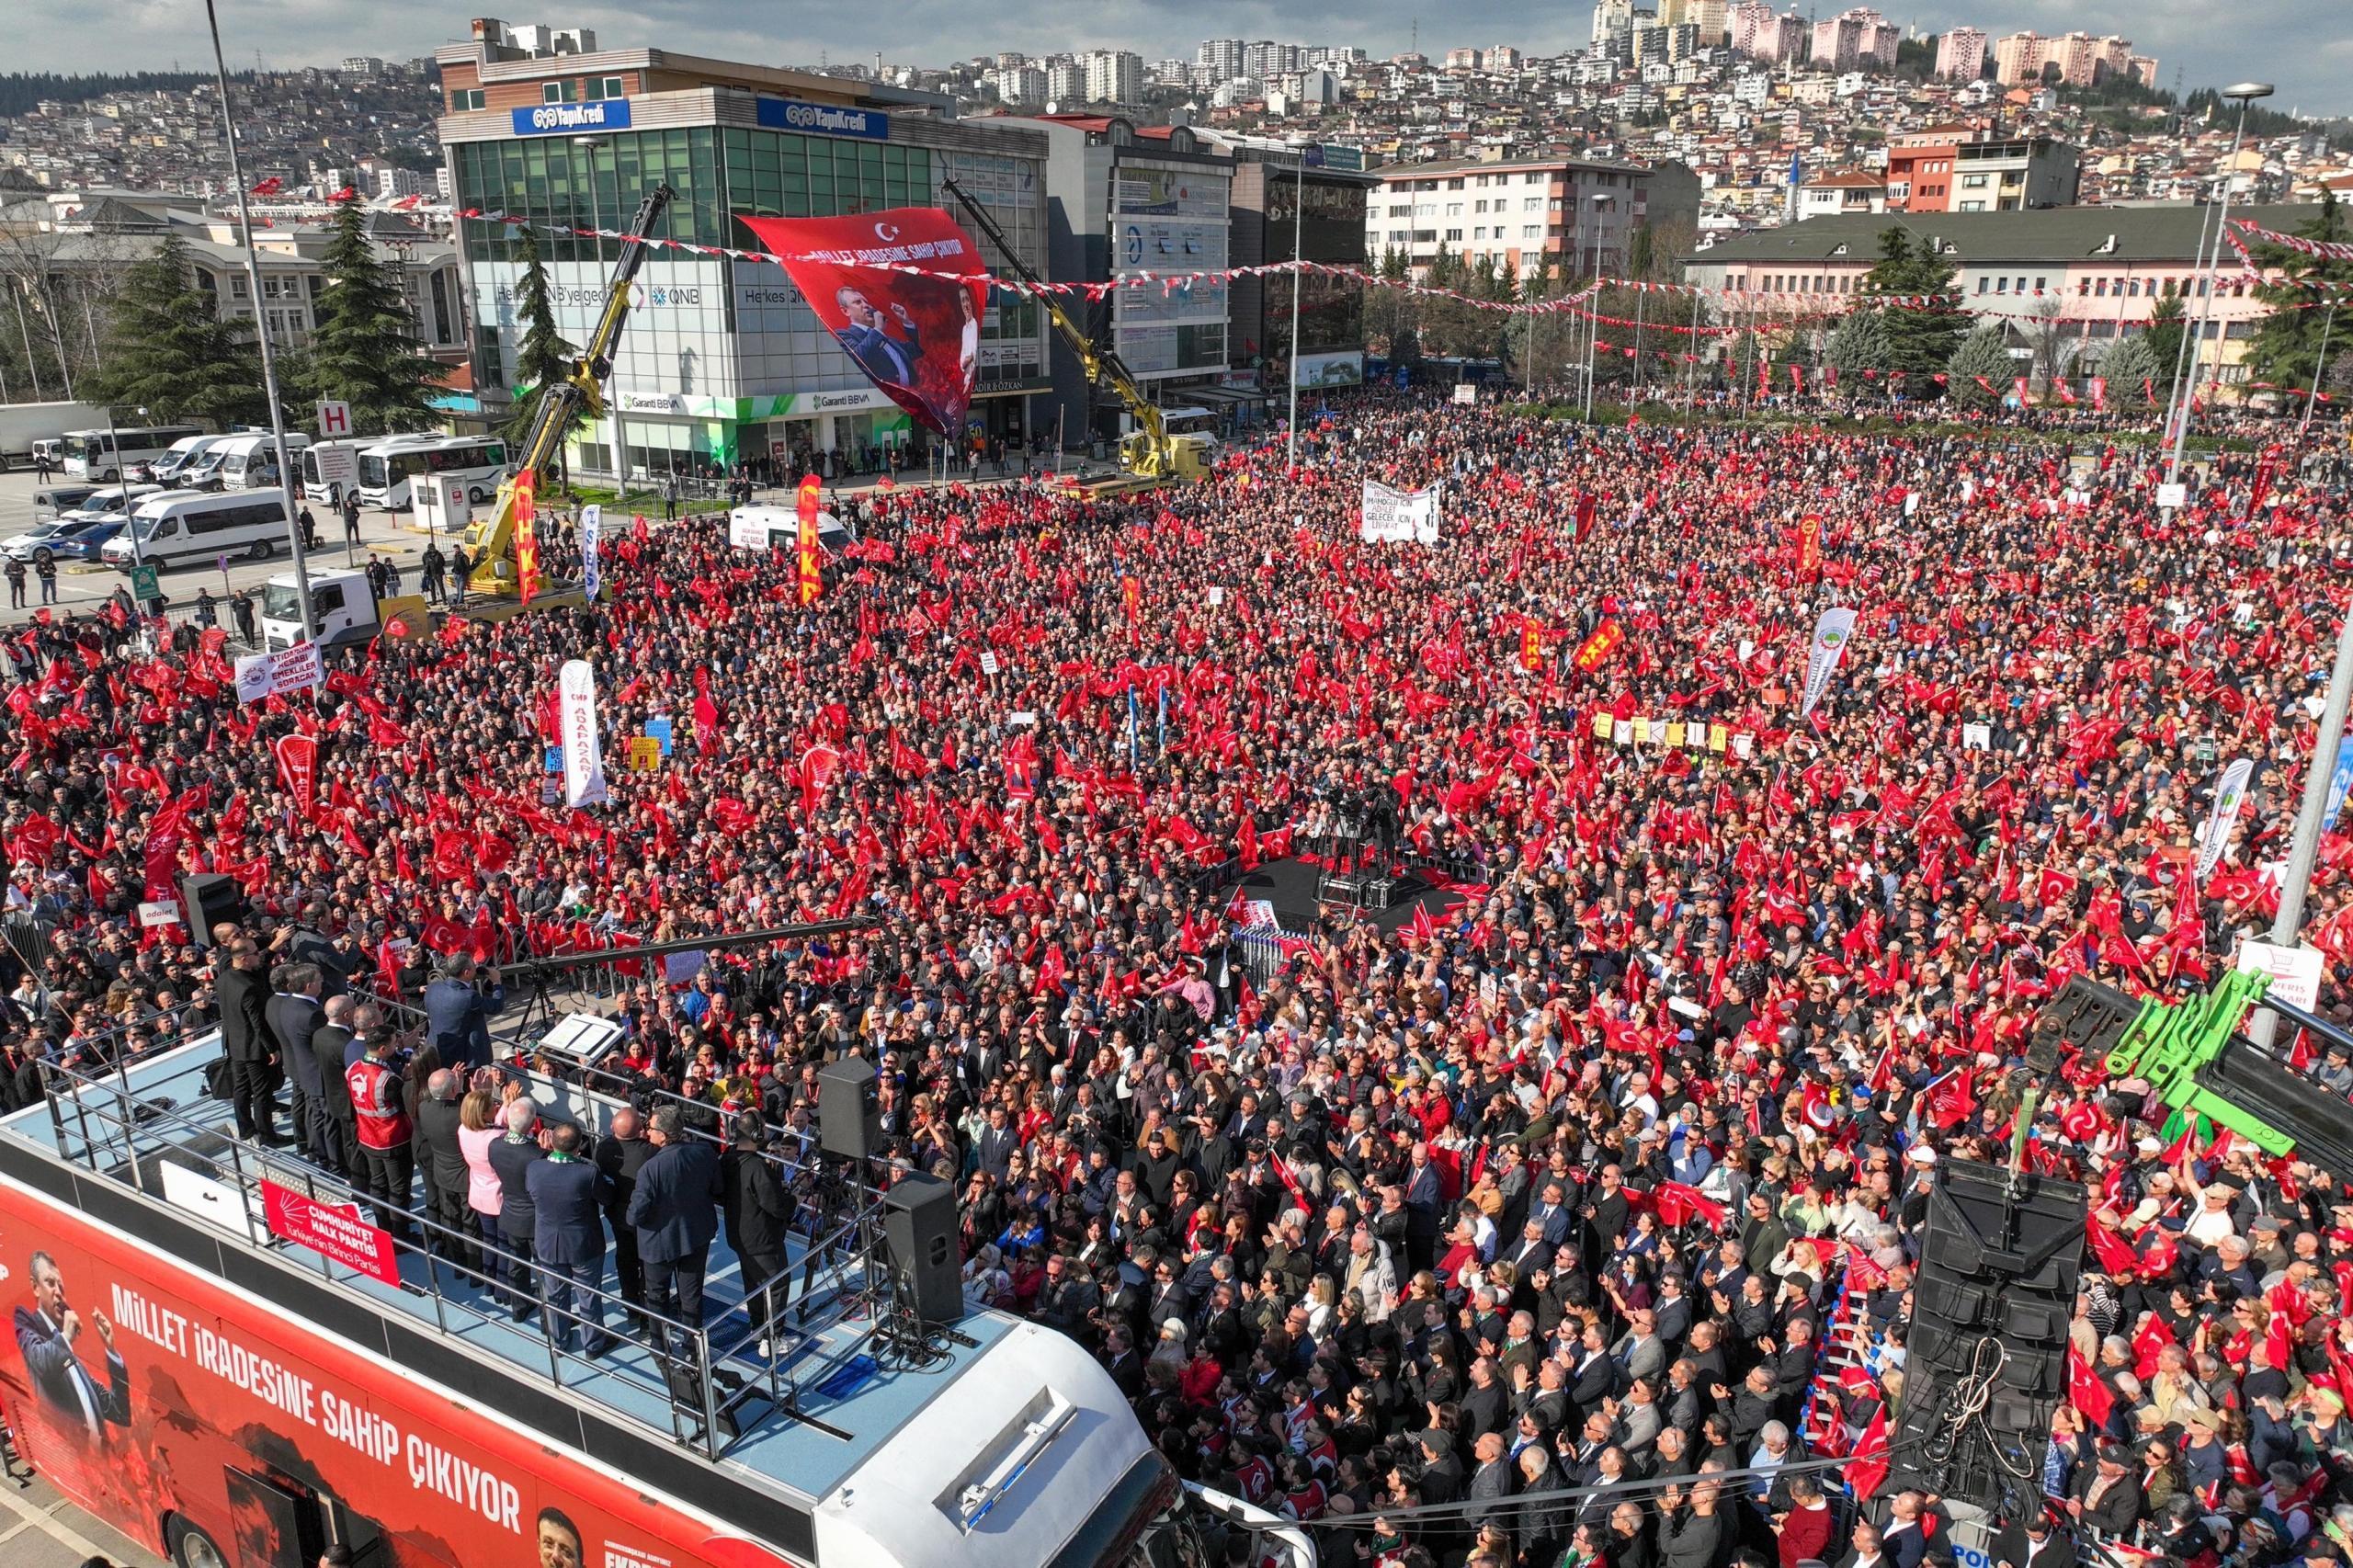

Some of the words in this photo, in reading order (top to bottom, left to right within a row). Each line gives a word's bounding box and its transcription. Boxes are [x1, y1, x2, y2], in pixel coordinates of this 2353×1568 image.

[669, 288, 699, 304] QNB
[745, 289, 785, 303] Herkes
[631, 396, 656, 409] Garanti
[657, 397, 679, 410] BBVA
[821, 394, 847, 407] Garanti
[847, 392, 870, 405] BBVA
[324, 406, 346, 432] H
[1366, 512, 1394, 522] GELECEK
[1371, 506, 1396, 514] ADALET
[585, 529, 595, 586] SES
[1527, 631, 1539, 669] HKP
[1578, 633, 1610, 665] HKP
[278, 653, 309, 669] HESABI
[271, 661, 317, 680] EMEKLİLER
[277, 671, 317, 689] SORACAK
[571, 693, 587, 701] CHP
[574, 707, 593, 780] ADAPAZARI
[145, 907, 173, 918] adalet
[308, 1205, 374, 1243] CUMHURİYET
[311, 1219, 338, 1242] HALK
[339, 1233, 378, 1259] PARTİSİ
[284, 1221, 328, 1250] Türkiye'nin
[328, 1242, 354, 1264] Birinci
[354, 1255, 381, 1276] Partisi
[406, 1433, 521, 1536] ÇIKIYOR
